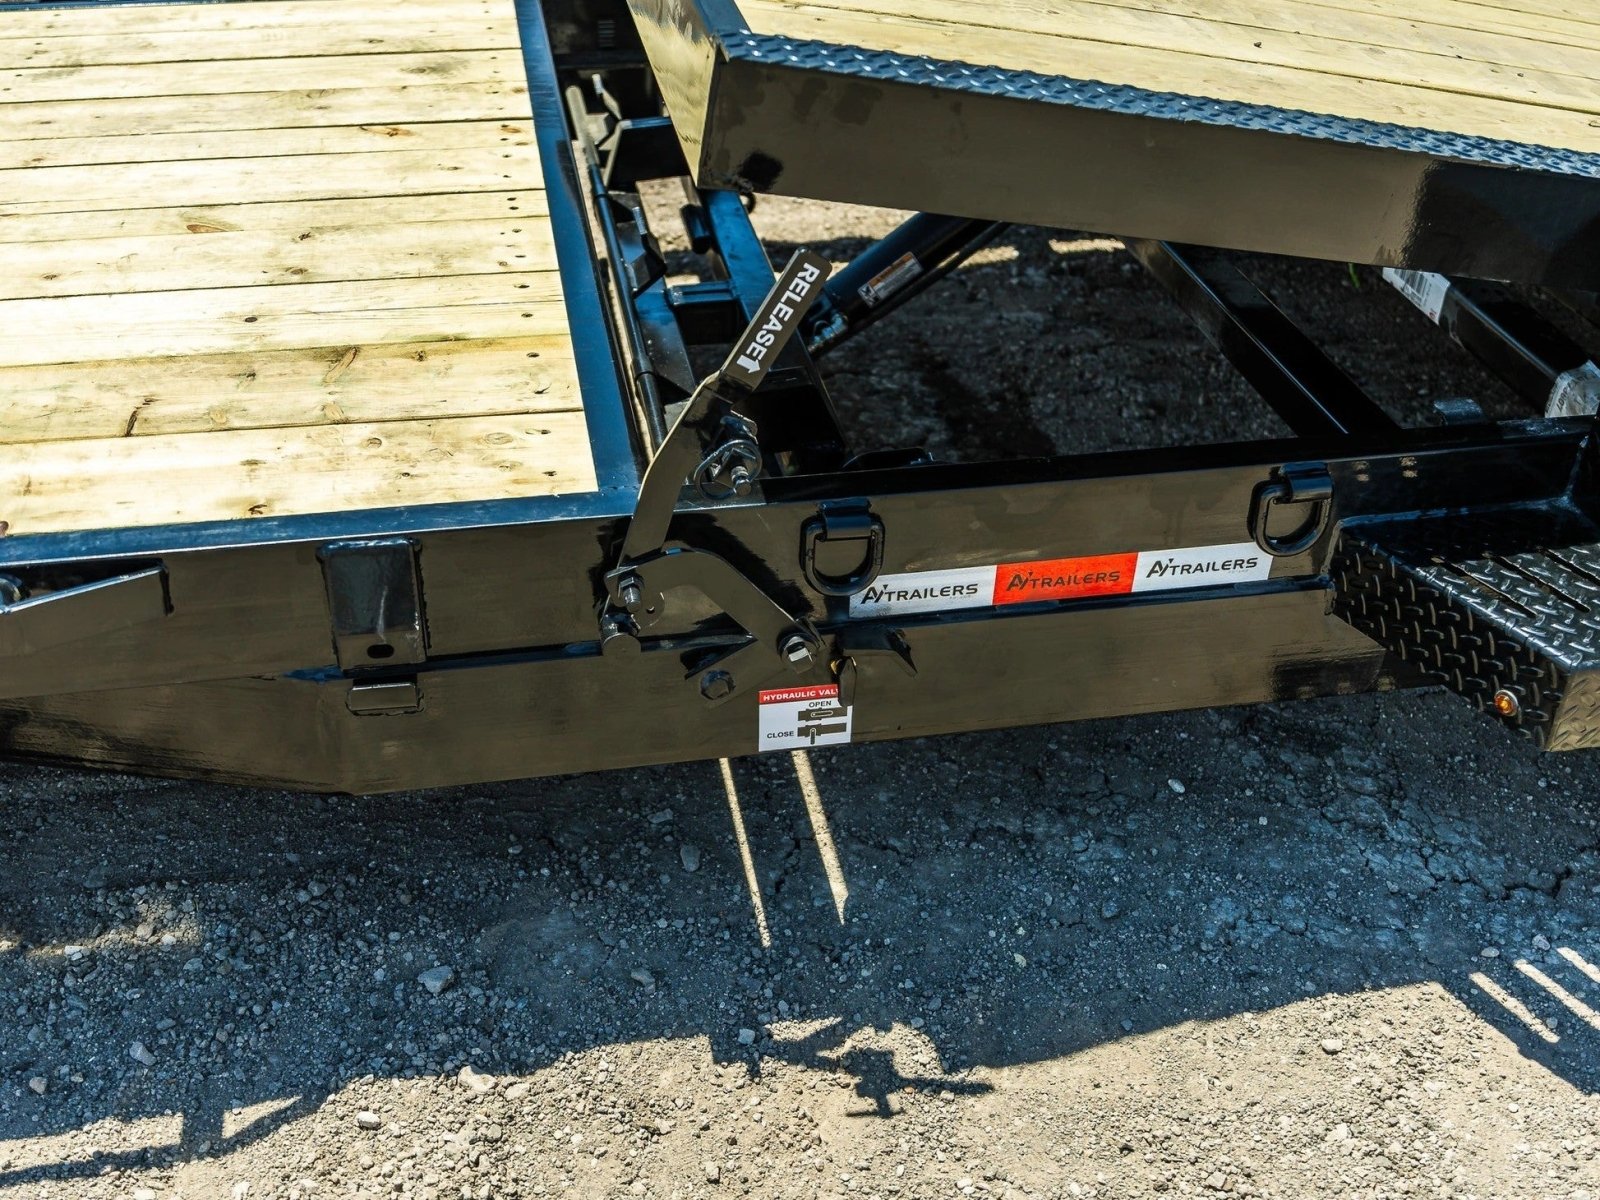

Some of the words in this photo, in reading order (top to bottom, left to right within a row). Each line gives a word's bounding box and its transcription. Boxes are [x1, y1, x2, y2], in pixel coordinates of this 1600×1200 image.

[745, 262, 820, 360] RELEASE
[763, 690, 817, 702] HYDRAULIC
[808, 700, 832, 708] OPEN
[766, 730, 795, 739] CLOSE
